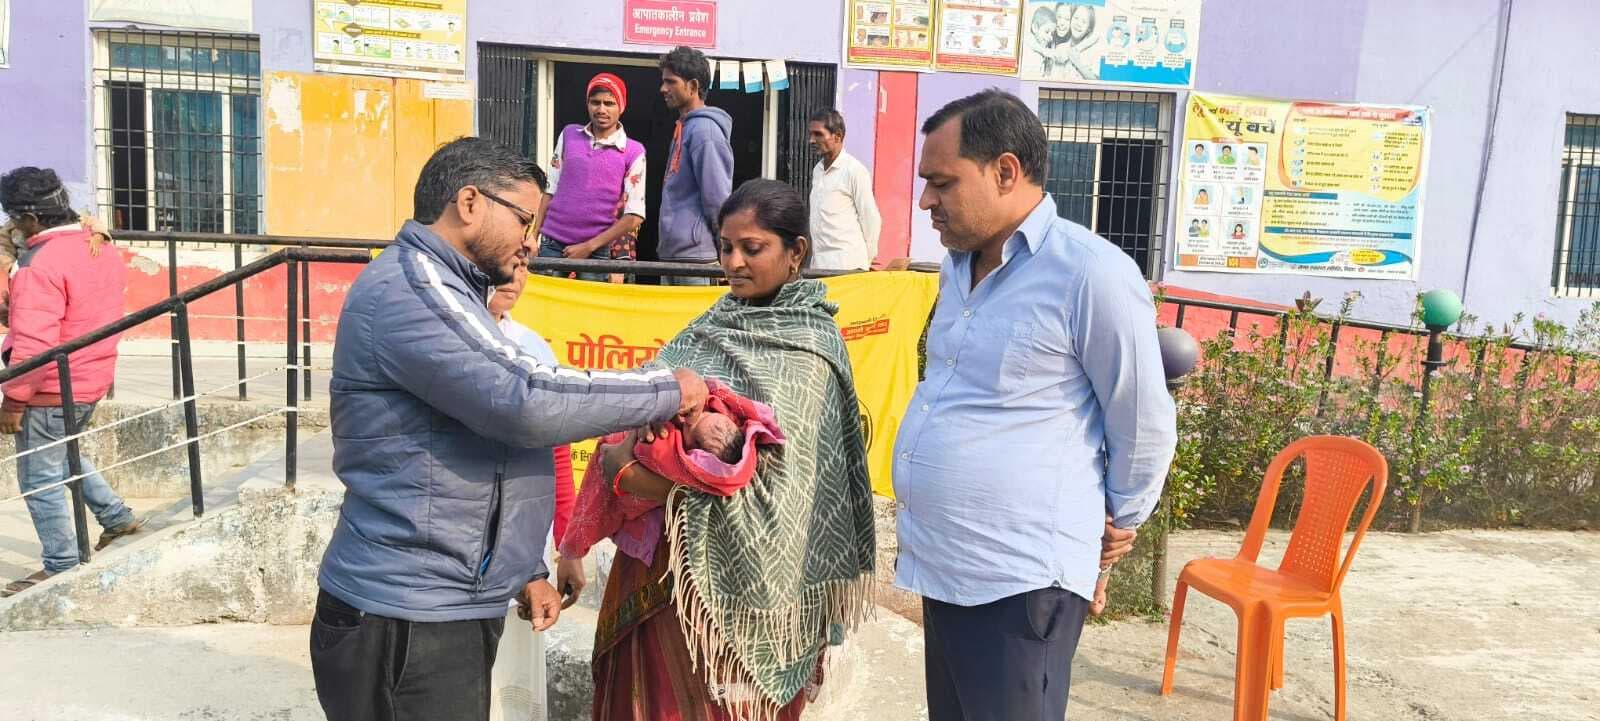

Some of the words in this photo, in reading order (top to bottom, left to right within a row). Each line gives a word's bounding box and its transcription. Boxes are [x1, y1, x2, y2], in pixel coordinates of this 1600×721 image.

[632, 6, 685, 21] आपातकालीन
[688, 8, 709, 23] प्रवेश
[634, 24, 673, 38] Emergency
[675, 26, 706, 38] Entrance
[1226, 118, 1243, 137] यूं
[1246, 119, 1276, 134] बचें
